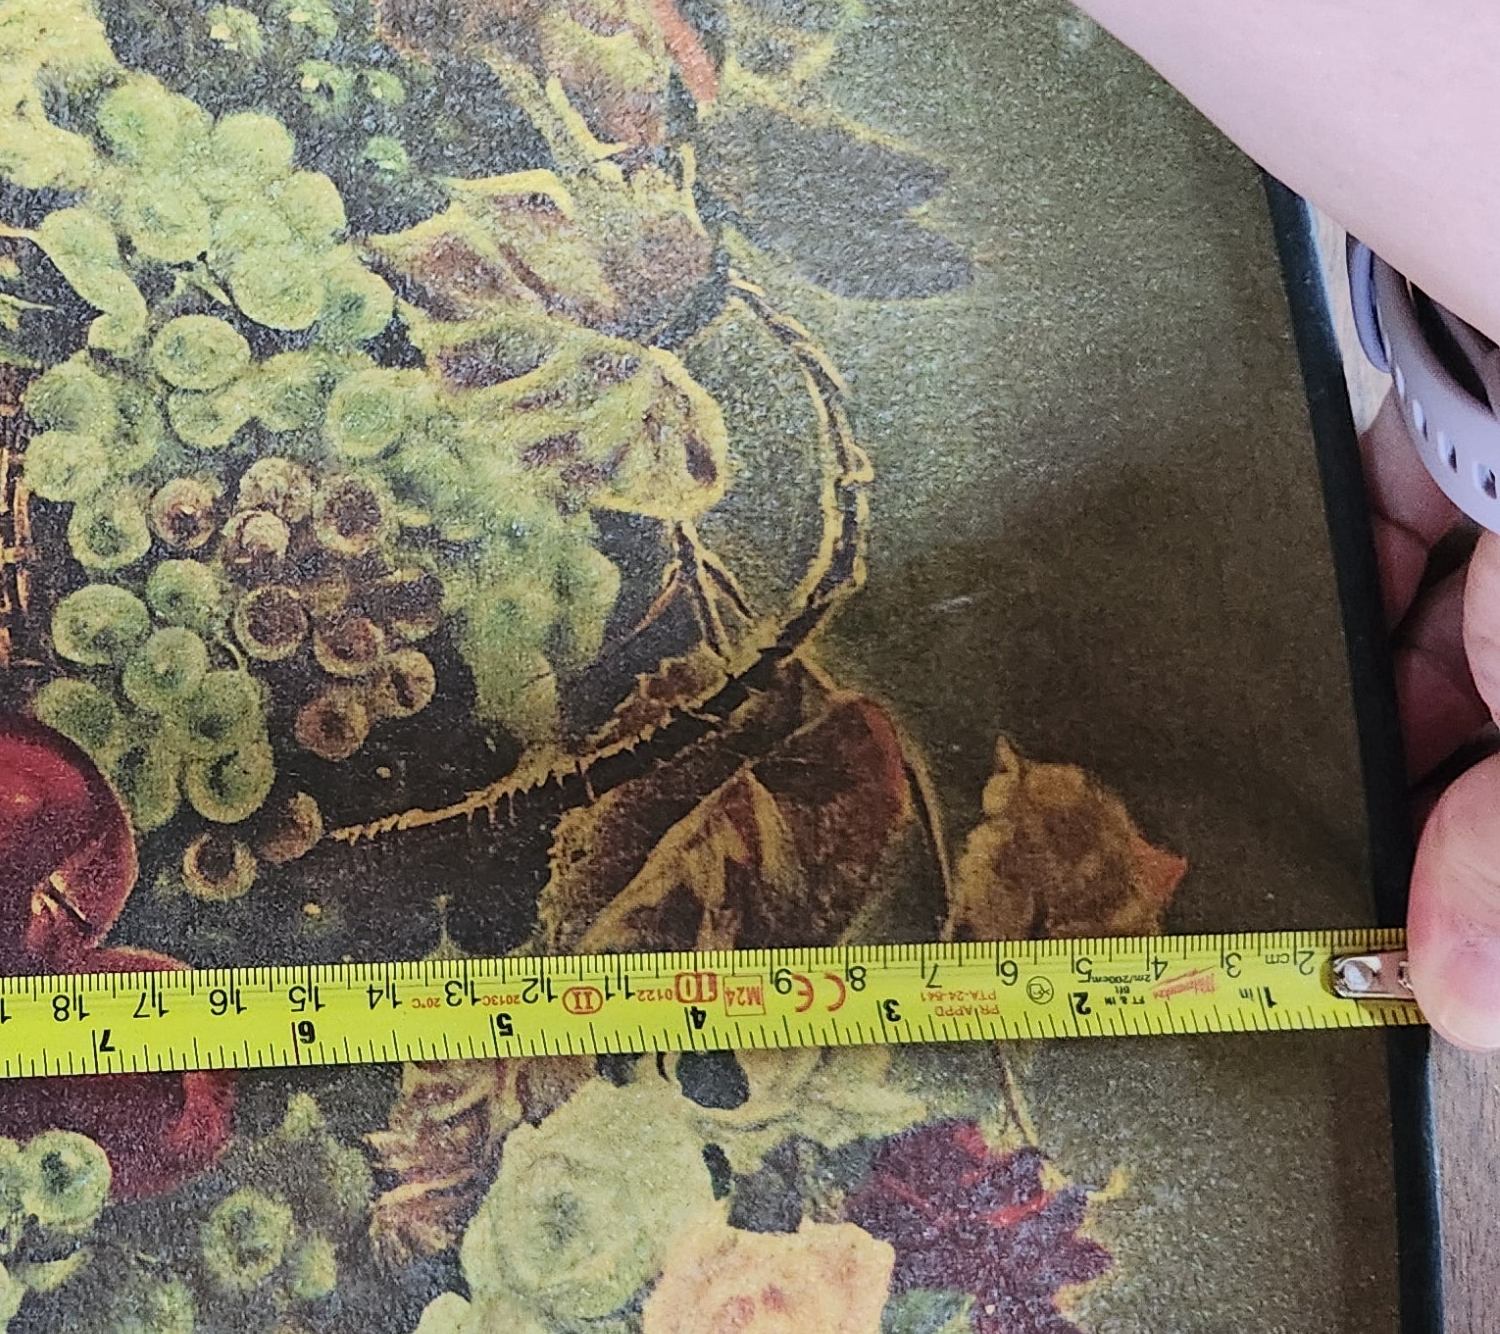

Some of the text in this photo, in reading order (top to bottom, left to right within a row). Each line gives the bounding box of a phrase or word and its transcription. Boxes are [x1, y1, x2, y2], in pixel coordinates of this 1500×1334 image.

[1074, 956, 1093, 984] 5
[1150, 955, 1169, 982] 4
[1225, 951, 1243, 979] 3
[1264, 952, 1291, 966] cm
[1296, 950, 1315, 976] 2
[773, 968, 793, 996] 9
[847, 965, 867, 993] 8
[925, 963, 943, 990] 7
[999, 960, 1019, 987] 6
[287, 984, 326, 1013] 15
[365, 982, 403, 1010] 14
[443, 980, 481, 1008] 13
[521, 976, 559, 1004] 12
[604, 974, 636, 1002] 11
[635, 988, 674, 1003] 0122
[674, 972, 716, 1003] 10
[724, 985, 763, 1007] M24
[1131, 994, 1146, 1006] FT
[1238, 987, 1254, 1003] in
[1262, 986, 1278, 1009] 1
[51, 994, 91, 1023] 18
[132, 991, 171, 1020] 17
[209, 988, 249, 1017] 16
[882, 998, 902, 1023] 3
[933, 1004, 974, 1018] APPD
[1071, 991, 1092, 1016] 2
[495, 1012, 514, 1038] 5
[689, 1005, 707, 1030] 4
[99, 1028, 117, 1053] 7
[297, 1020, 317, 1046] 6
